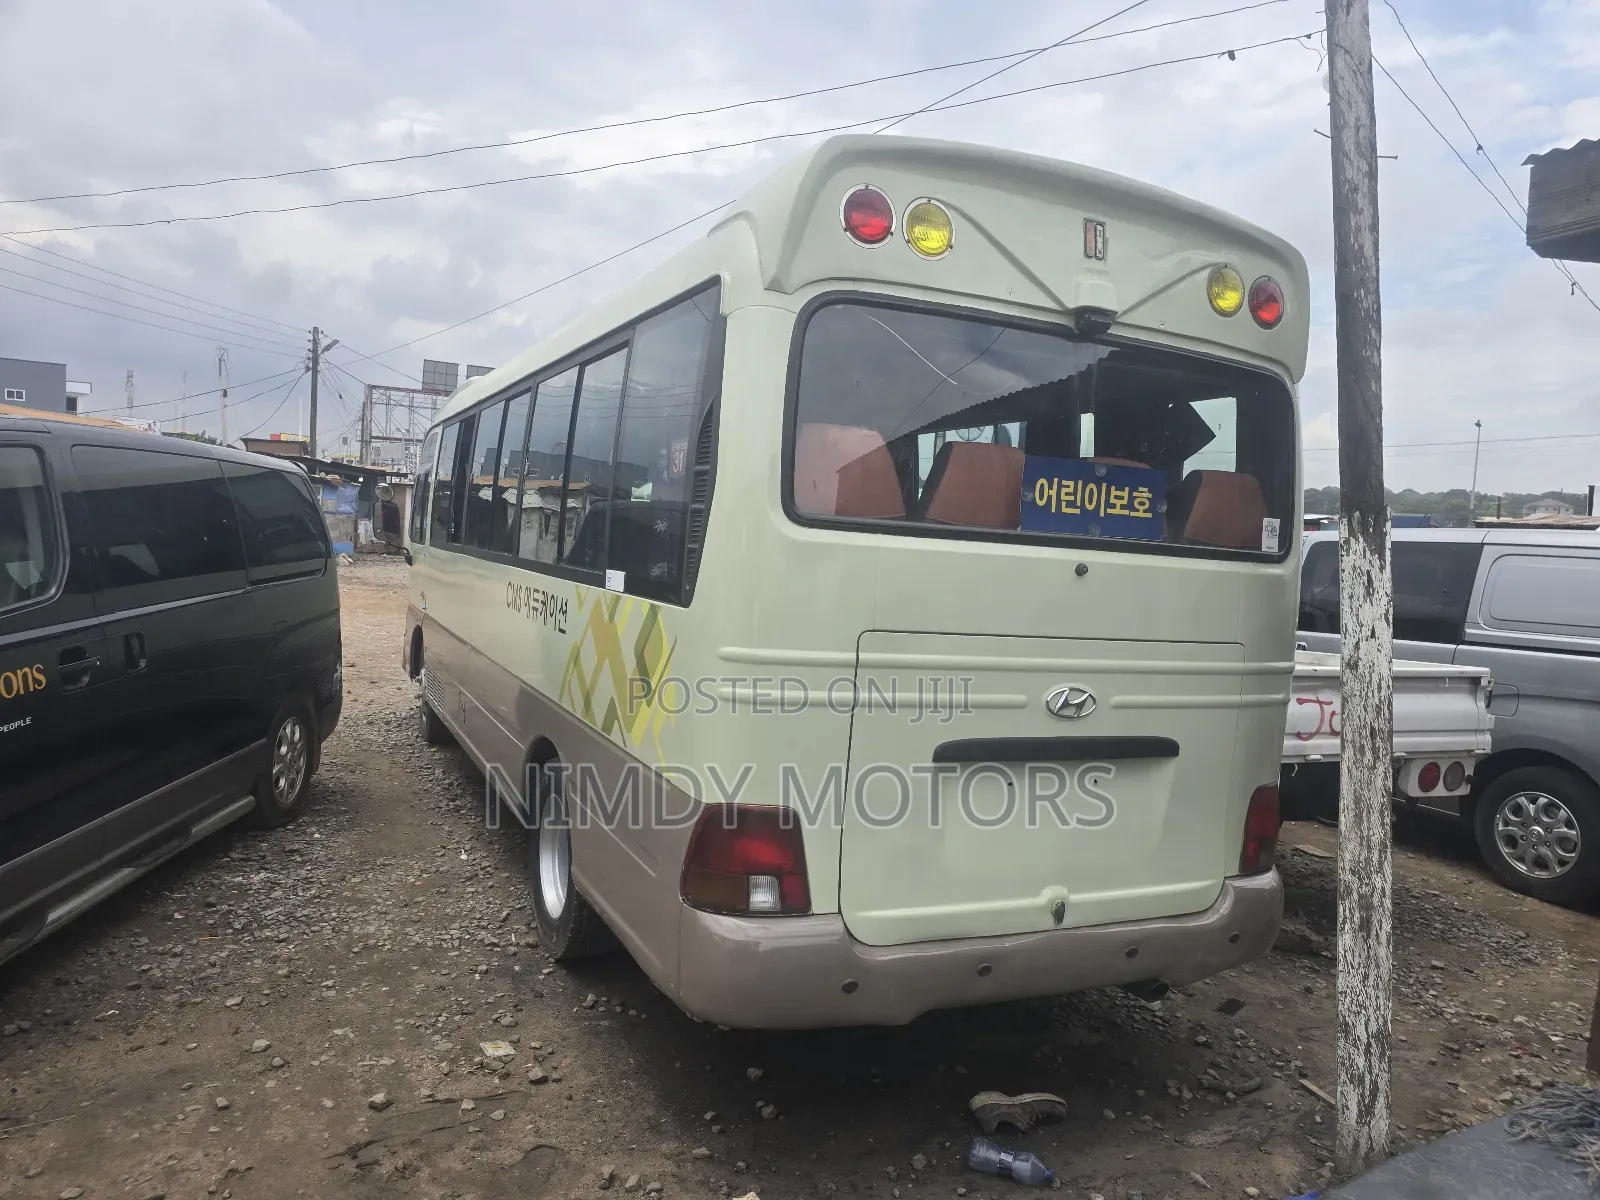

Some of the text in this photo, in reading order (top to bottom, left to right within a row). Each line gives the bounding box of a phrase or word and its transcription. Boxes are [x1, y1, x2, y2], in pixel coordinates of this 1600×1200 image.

[672, 451, 684, 473] 31
[1034, 477, 1153, 518] 어린이보호
[506, 581, 568, 635] CMS 에듀케이션
[0, 664, 47, 699] ons
